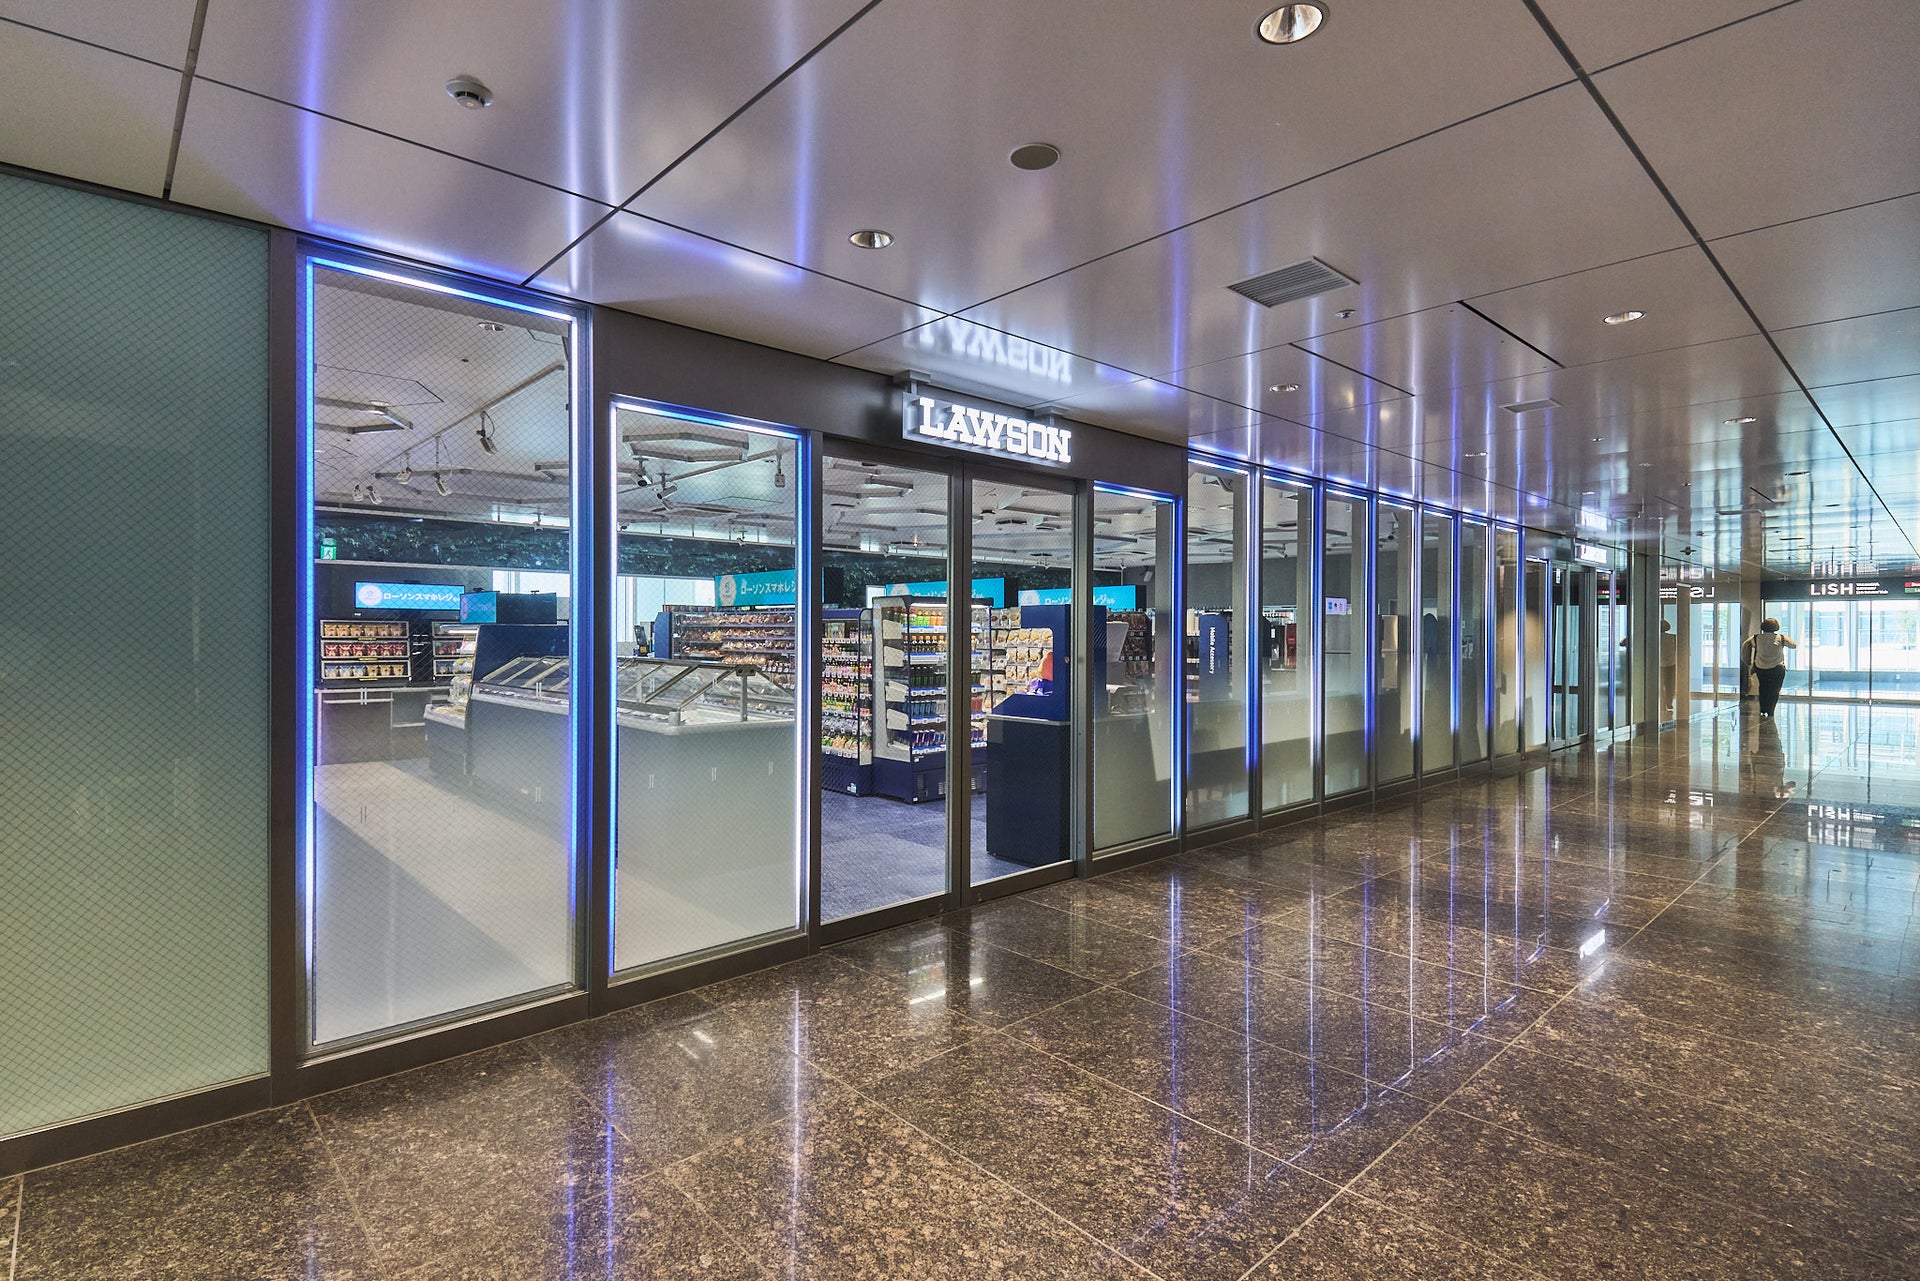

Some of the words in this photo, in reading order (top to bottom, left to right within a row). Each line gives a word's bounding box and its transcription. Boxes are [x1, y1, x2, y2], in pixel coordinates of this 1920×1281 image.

[919, 397, 1072, 463] LAWSON
[1208, 627, 1216, 646] Mobile
[1207, 647, 1216, 674] Accessory
